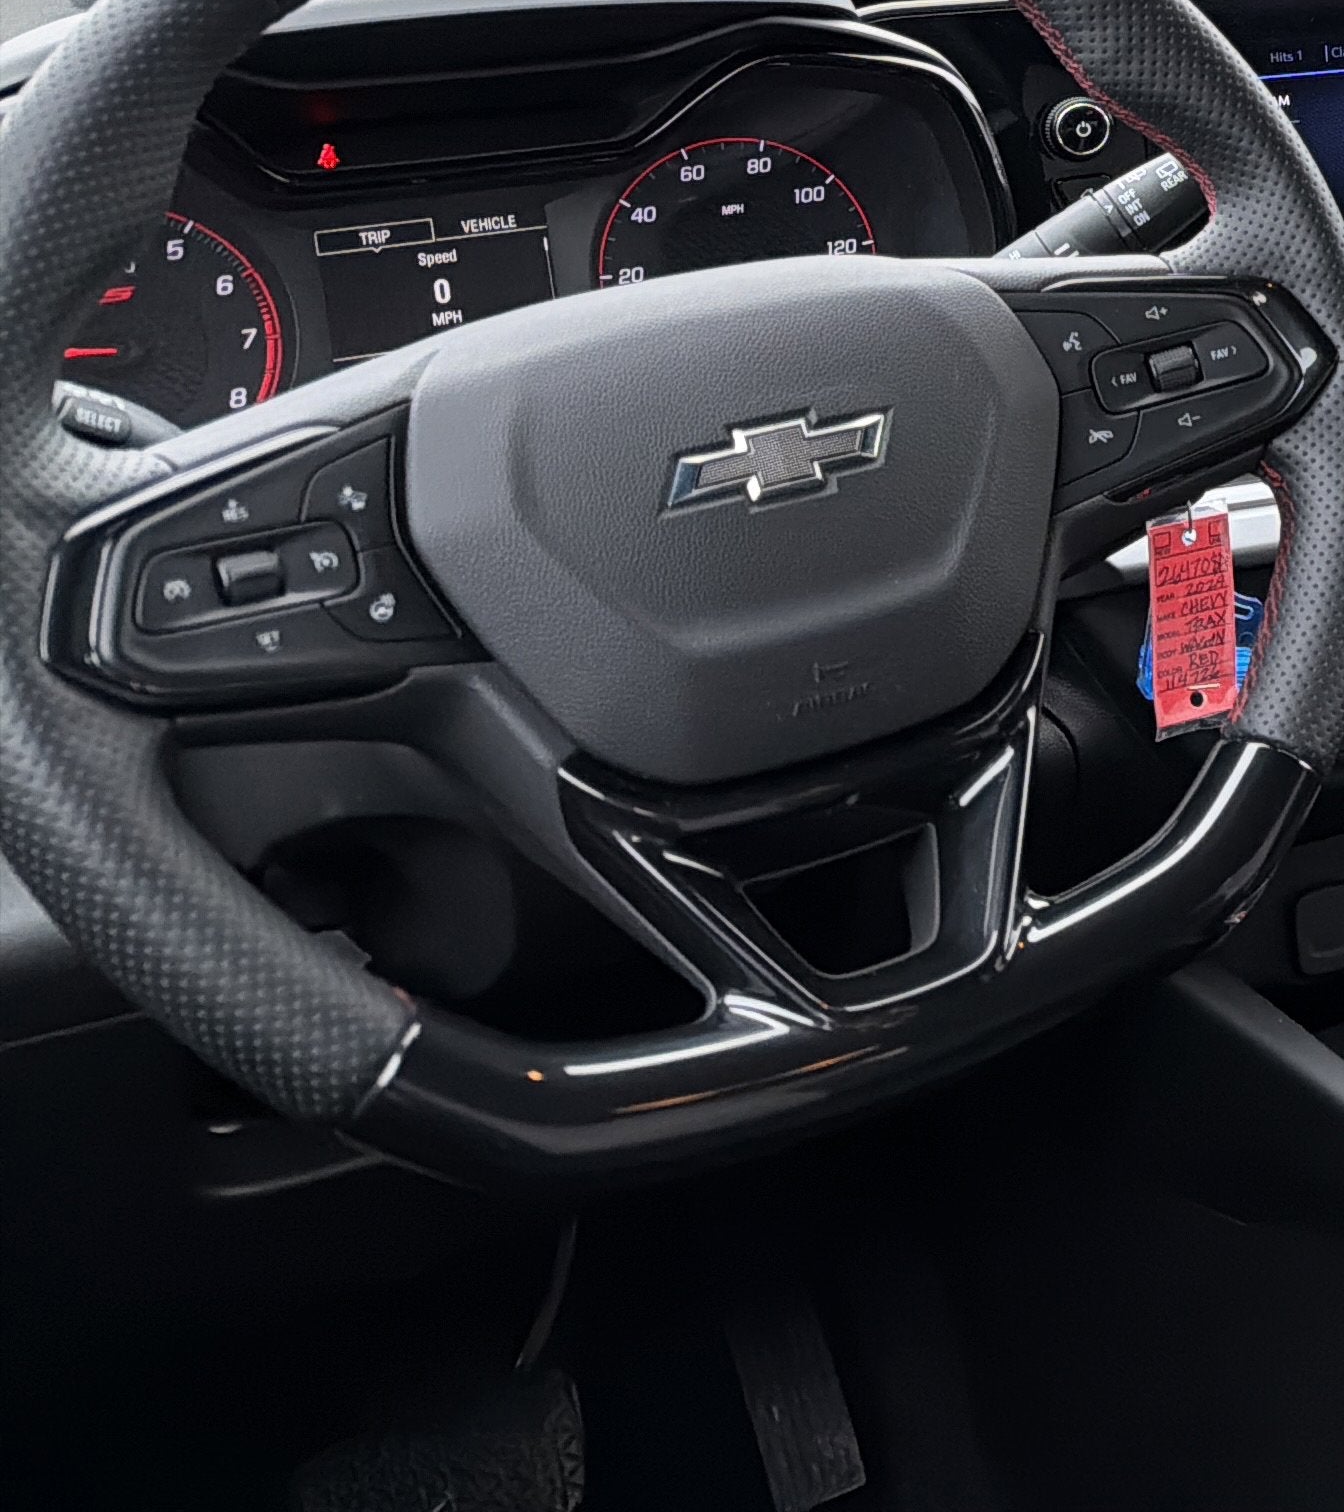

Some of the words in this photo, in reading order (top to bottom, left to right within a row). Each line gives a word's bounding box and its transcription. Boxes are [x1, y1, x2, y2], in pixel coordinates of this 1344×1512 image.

[1270, 51, 1293, 63] Hits
[1297, 50, 1303, 61] 1
[680, 164, 705, 182] 60
[746, 157, 771, 175] 80
[1160, 169, 1189, 192] REAR
[793, 186, 825, 204] 100
[1117, 188, 1137, 205] OFF
[630, 206, 657, 223] 40
[721, 203, 745, 216] MPH
[1125, 197, 1144, 216] INT
[461, 214, 517, 234] VEHICLE
[1133, 211, 1151, 227] ON
[359, 229, 391, 246] TRIP
[166, 239, 184, 261] 5
[827, 238, 857, 256] 120
[418, 248, 458, 268] Speed
[618, 266, 644, 285] 20
[216, 274, 234, 296] 6
[433, 278, 451, 304] 0
[432, 309, 462, 327] MPH
[241, 327, 257, 350] 7
[1210, 347, 1229, 361] FAV
[1120, 372, 1137, 385] FAV
[229, 387, 248, 409] 8
[1181, 590, 1228, 616] CHEVY
[1185, 609, 1226, 632] TRAX
[1189, 650, 1219, 670] RED
